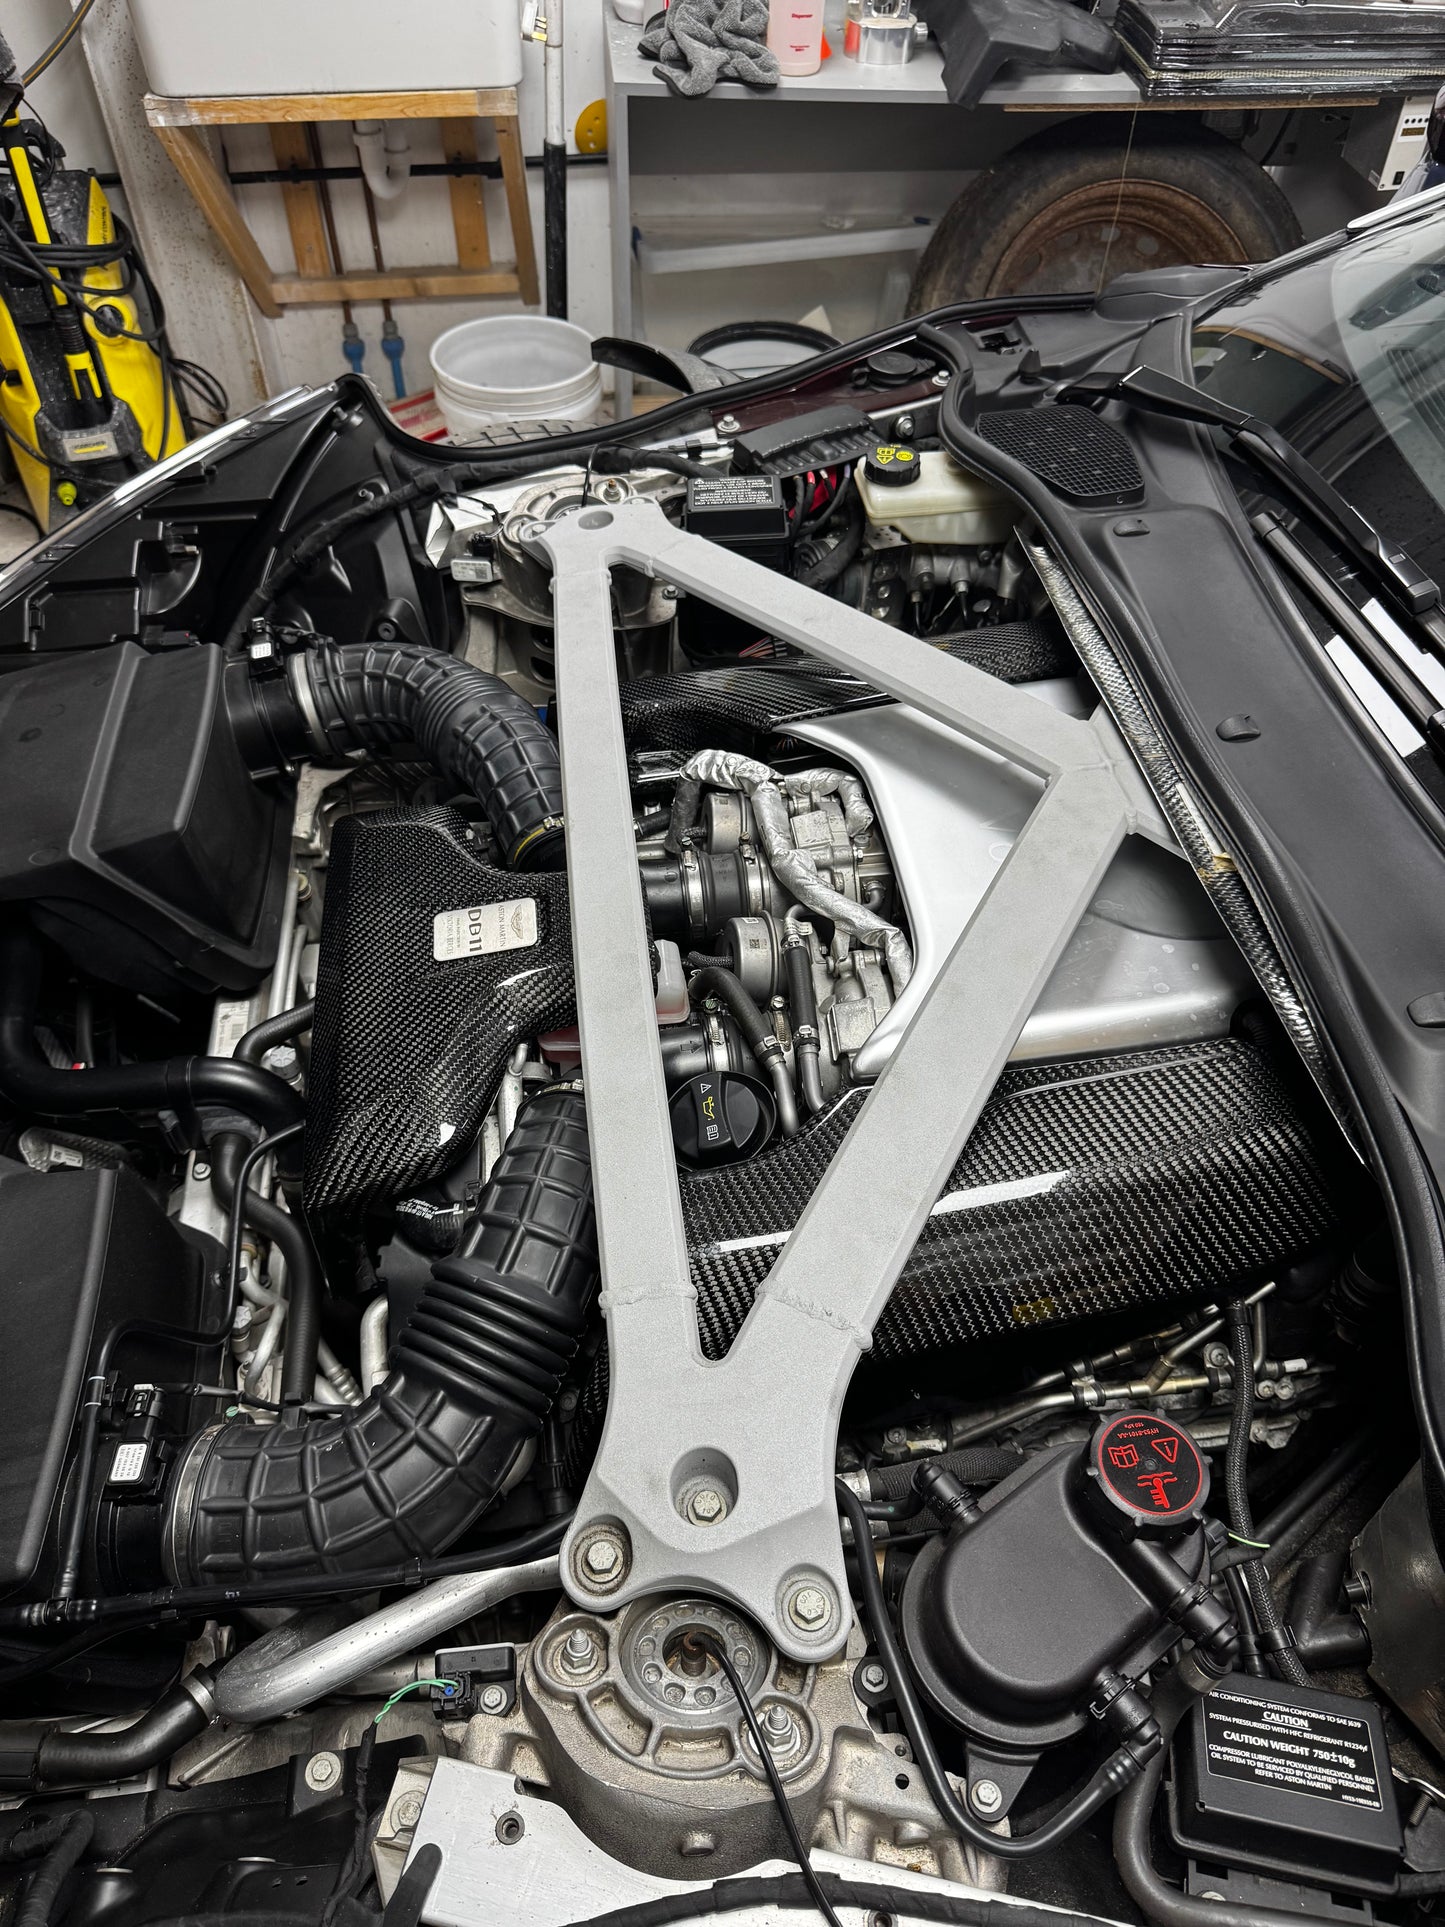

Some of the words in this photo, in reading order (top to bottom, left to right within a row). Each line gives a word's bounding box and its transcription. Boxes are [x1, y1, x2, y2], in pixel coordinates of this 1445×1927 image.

[468, 908, 482, 952] DB11
[1209, 1712, 1231, 1722] SYSTEM
[1232, 1716, 1271, 1730] PRESSURISED
[1271, 1726, 1288, 1734] WITH
[1303, 1732, 1343, 1746] REFRIGERANT
[1220, 1693, 1266, 1708] CONDITIONING
[1267, 1704, 1289, 1712] SYSTEM
[1290, 1708, 1326, 1720] CONFORMS
[1348, 1720, 1362, 1728] J639
[1263, 1711, 1309, 1727] CAUTION
[1208, 1744, 1250, 1758] COMPRESSOR
[1251, 1752, 1285, 1765] LUBRICANT
[1286, 1760, 1354, 1780] POLYALKYLENEGLYCOL
[1354, 1774, 1375, 1785] BASED
[1223, 1730, 1269, 1748] CAUTION
[1270, 1740, 1310, 1756] WEIGHT
[1312, 1749, 1356, 1769] 750±10g
[1222, 1754, 1246, 1764] SYSTEM
[1265, 1763, 1294, 1775] SERVICED
[1304, 1771, 1337, 1784] QUALIFIED
[1338, 1779, 1375, 1793] PERSONNEL
[1254, 1768, 1273, 1778] REFER
[1284, 1775, 1306, 1785] ASTON
[1307, 1781, 1333, 1791] MARTIN
